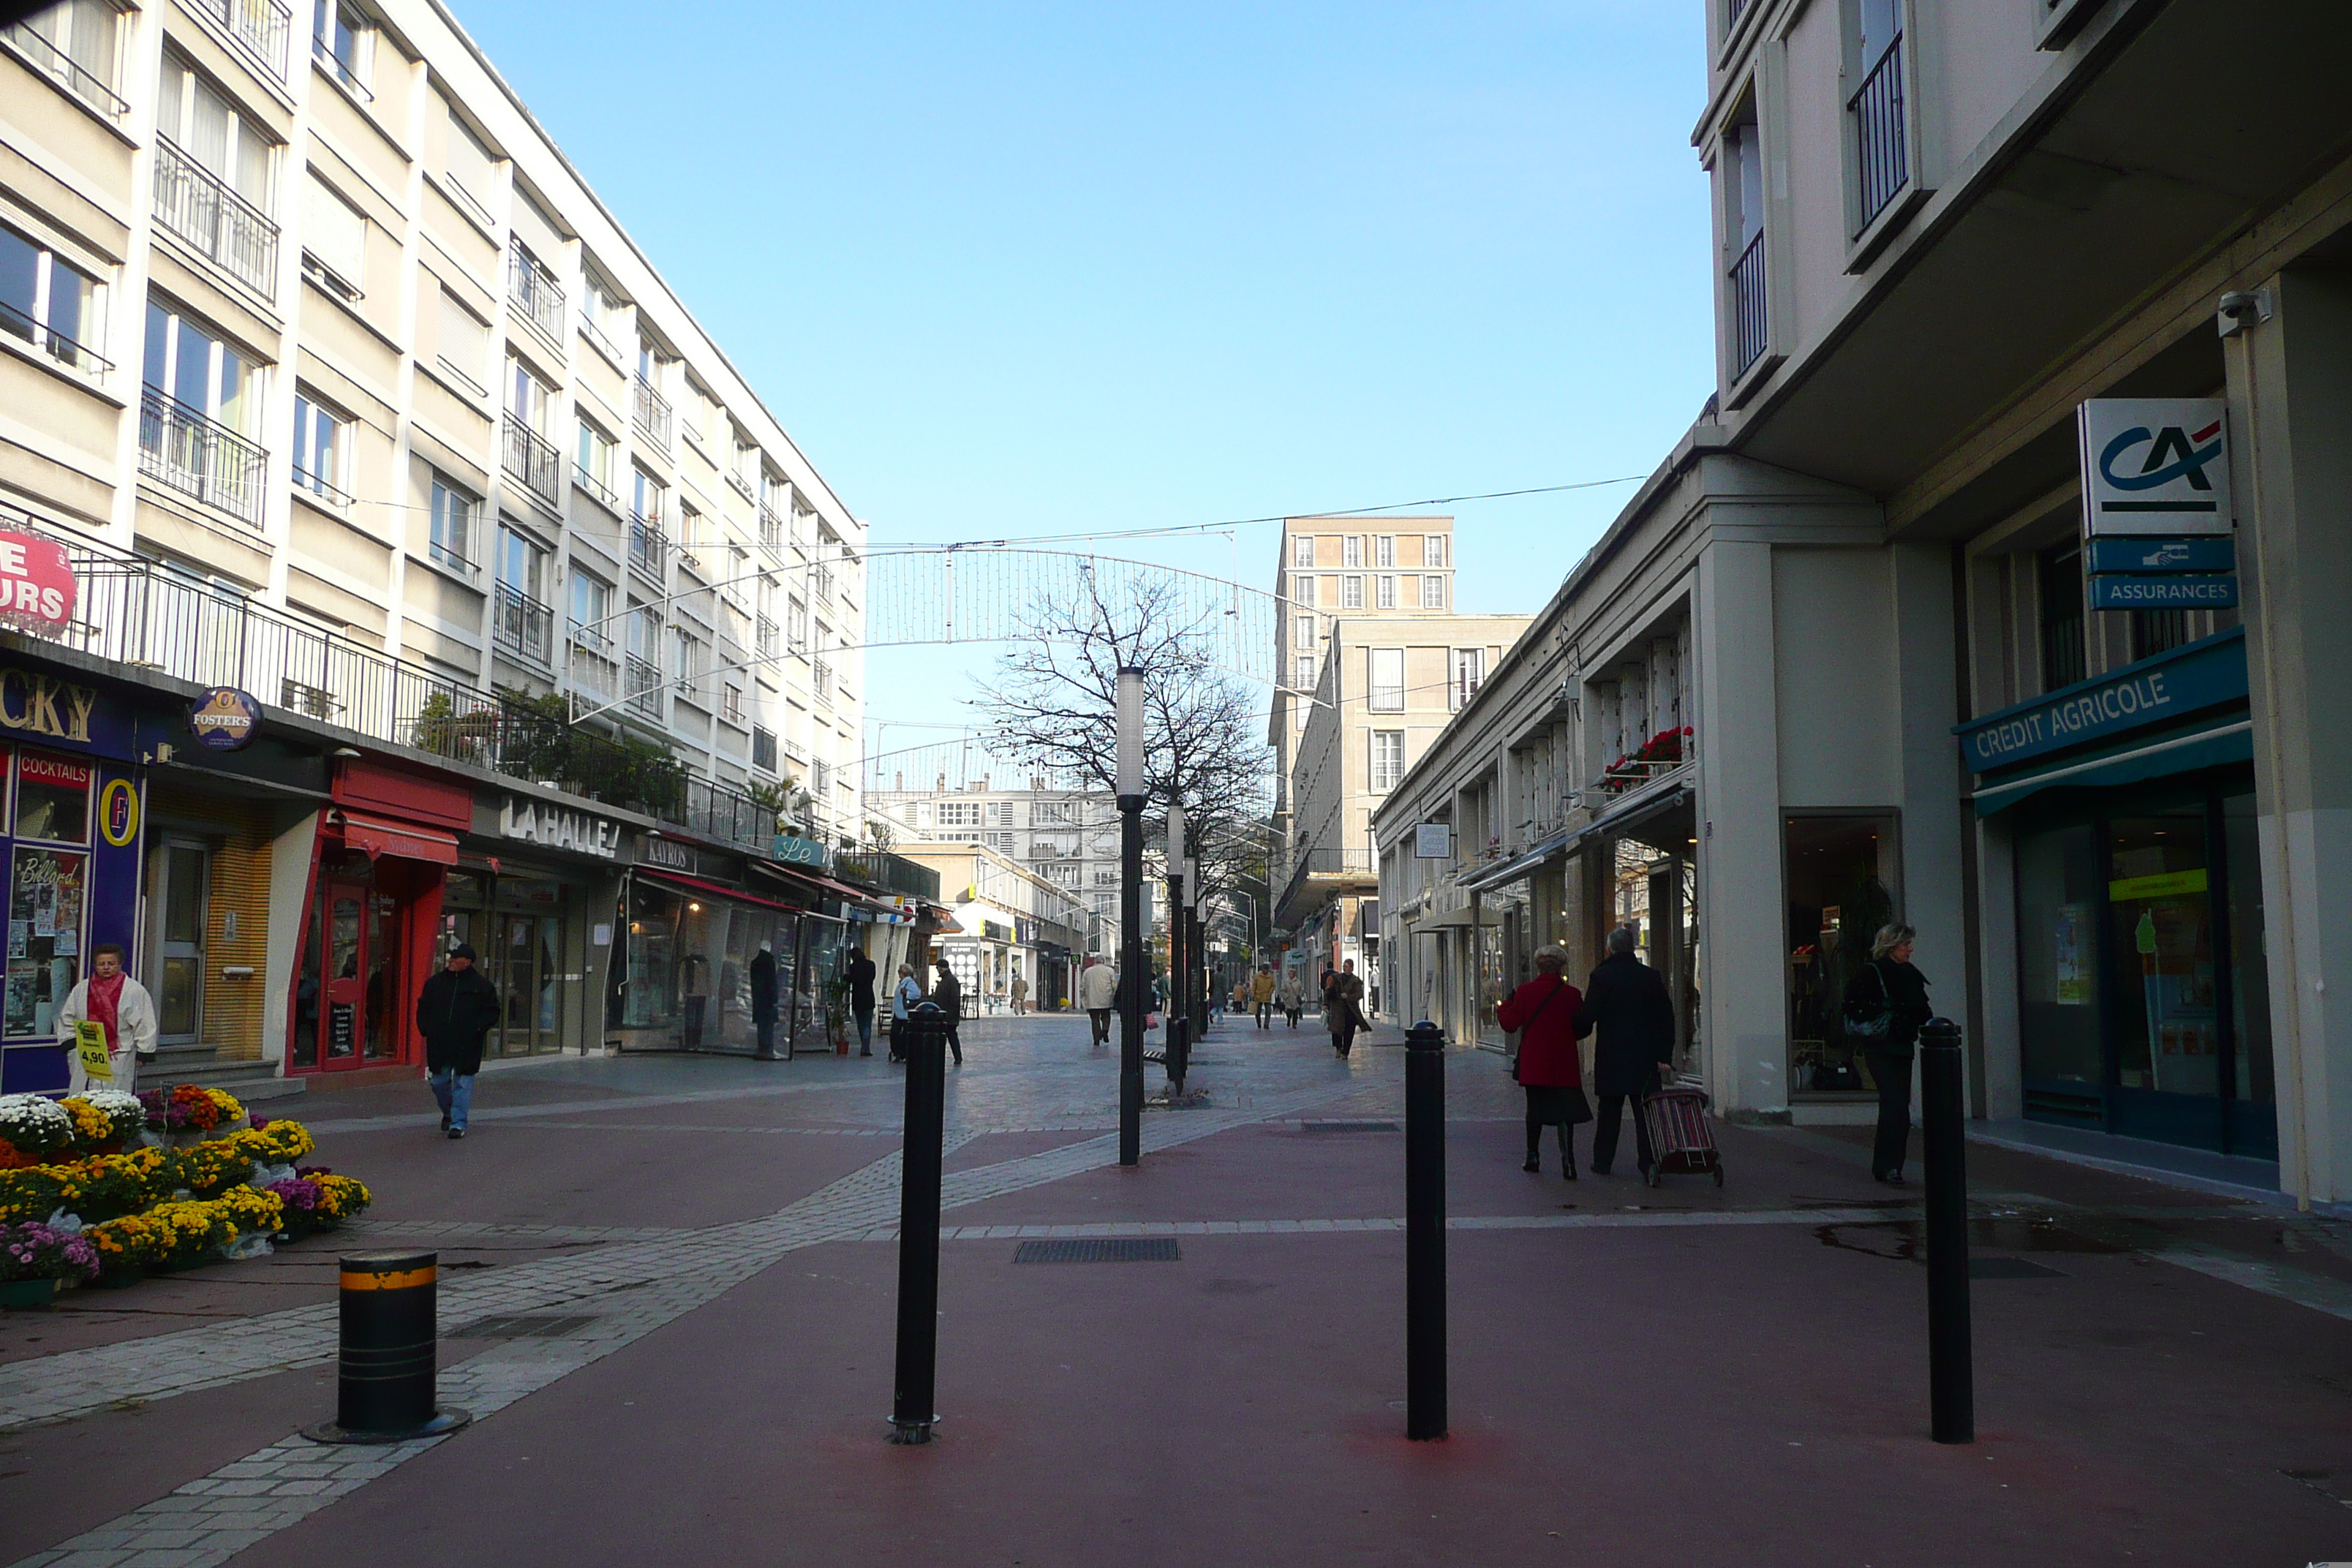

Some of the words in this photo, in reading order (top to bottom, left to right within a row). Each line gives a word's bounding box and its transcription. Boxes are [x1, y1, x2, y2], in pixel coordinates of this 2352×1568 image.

[2100, 420, 2222, 491] CA
[2110, 585, 2228, 600] ASSURANCES
[193, 714, 252, 727] FOSTER'S
[1977, 714, 2042, 758] CREDIT
[2051, 672, 2171, 736] AGRICOLE
[21, 756, 86, 783] COCKTAILS
[649, 839, 686, 867] KAYROS
[778, 837, 811, 863] Le
[20, 858, 78, 884] Billard
